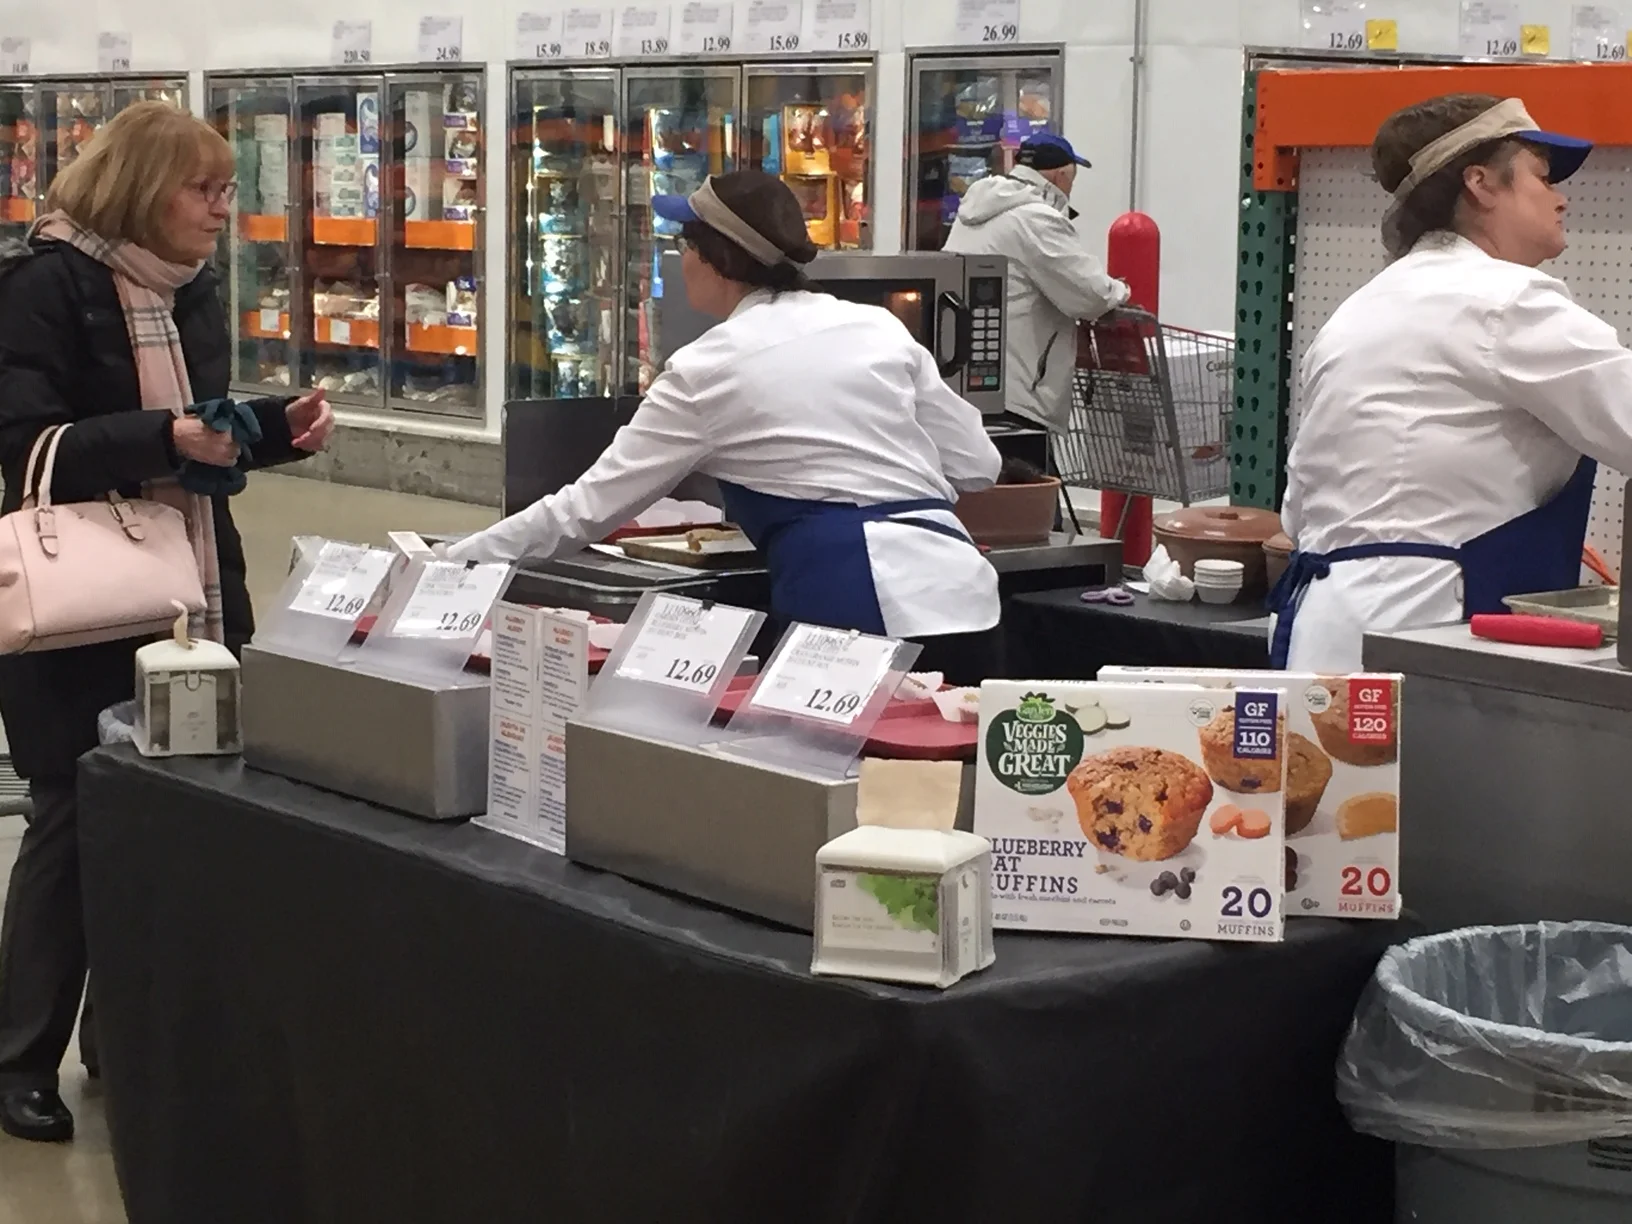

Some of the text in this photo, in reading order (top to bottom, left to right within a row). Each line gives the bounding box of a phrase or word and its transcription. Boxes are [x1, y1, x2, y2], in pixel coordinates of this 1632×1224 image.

[837, 32, 868, 48] 15.89
[982, 24, 1017, 41] 26.99
[1329, 32, 1363, 49] 12.69
[536, 43, 561, 58] 15.99
[641, 39, 668, 54] 13.89
[702, 37, 731, 51] 12.99
[769, 35, 799, 51] 15.69
[1486, 40, 1517, 55] 12.69
[1596, 43, 1625, 59] 12.69
[325, 593, 365, 615] 12.69
[436, 612, 482, 632] 12.69
[665, 658, 717, 684] 12.69
[805, 688, 861, 715] 12.69
[1358, 688, 1383, 703] GF
[1244, 702, 1269, 717] GF
[1002, 720, 1067, 743] VEGGIES
[1353, 717, 1387, 732] 120
[1014, 738, 1056, 754] MADE
[1239, 731, 1271, 747] 110
[997, 752, 1071, 778] GREAT
[985, 837, 1087, 858] LUEBERRY
[990, 855, 1021, 873] AT
[991, 872, 1078, 894] UFFINS
[1341, 866, 1391, 896] 20
[1221, 886, 1272, 918] 20
[1338, 901, 1394, 913] MUFFINS
[1217, 924, 1275, 937] MUFFINS
